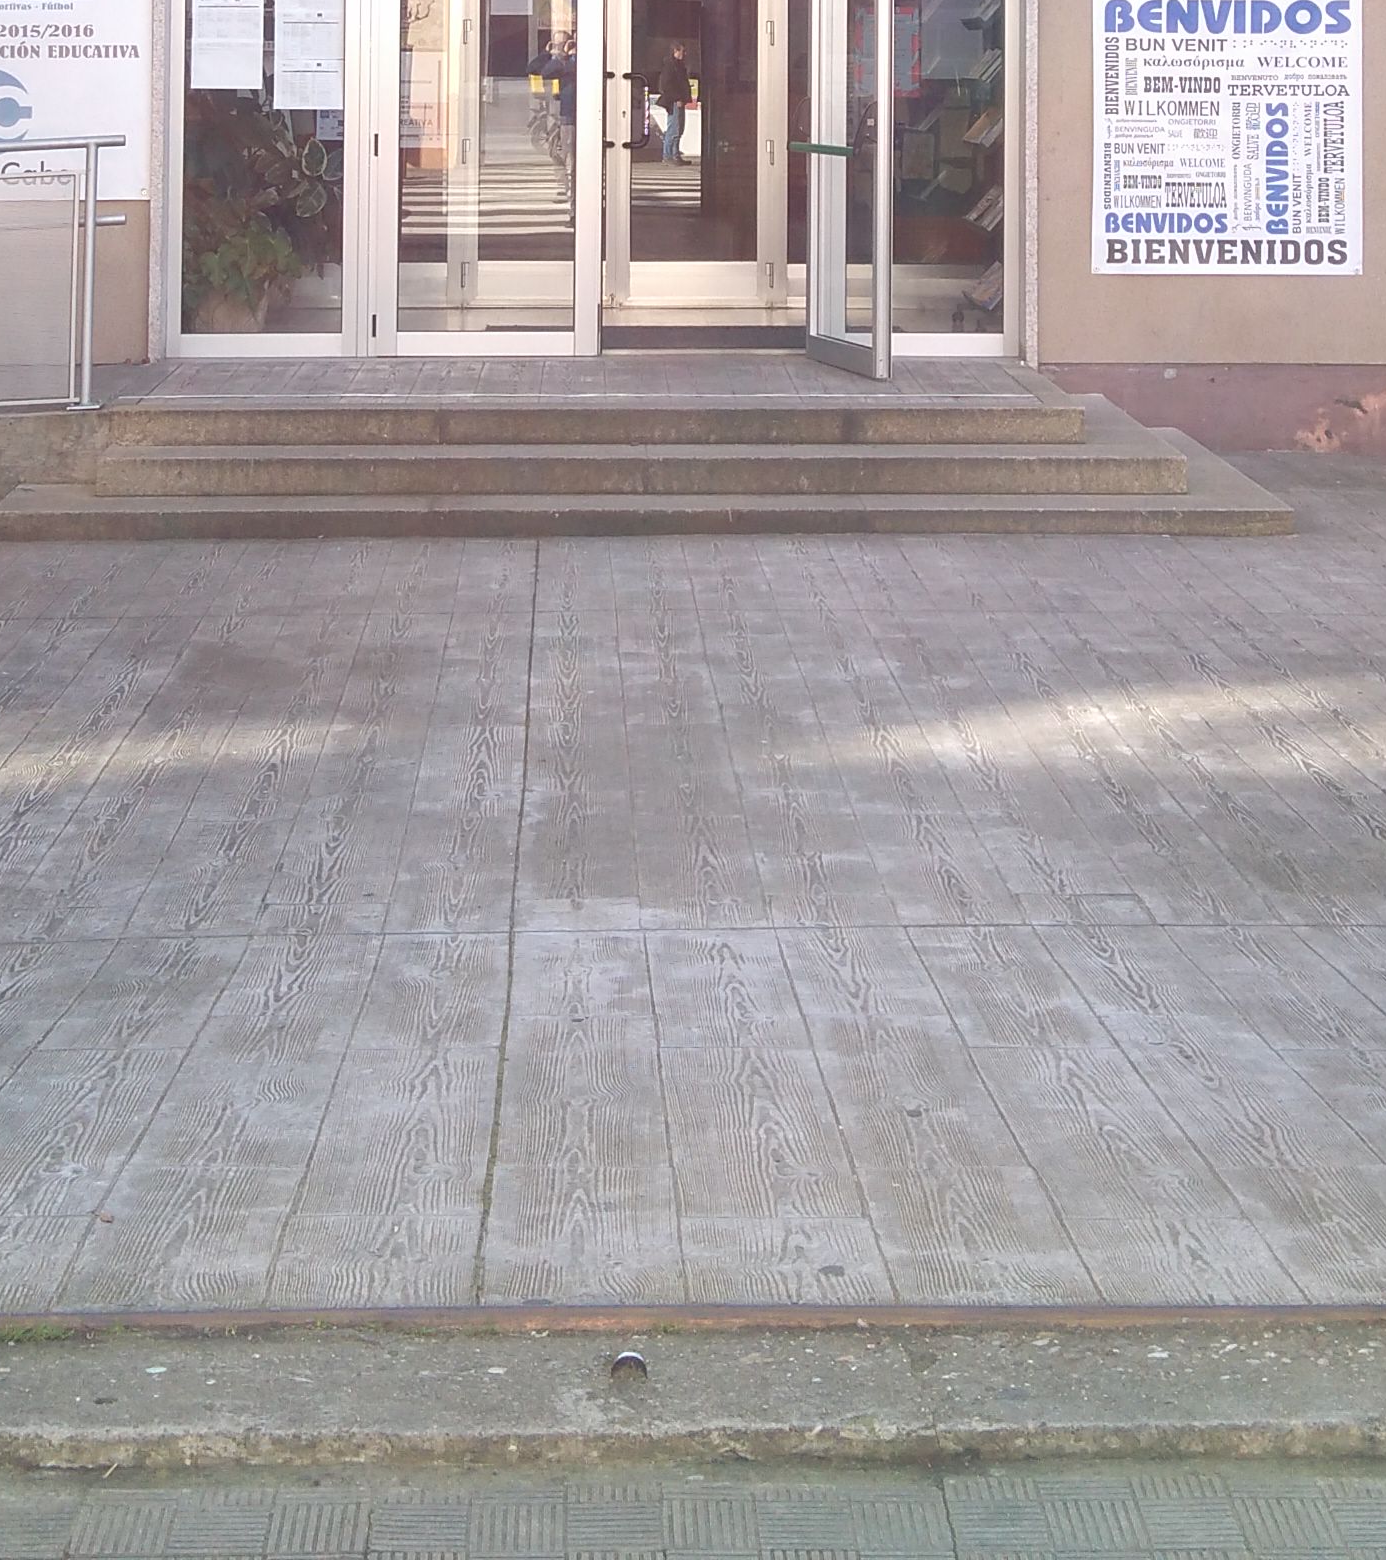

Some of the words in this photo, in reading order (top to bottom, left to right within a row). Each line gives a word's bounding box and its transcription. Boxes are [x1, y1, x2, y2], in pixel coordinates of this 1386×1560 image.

[48, 45, 141, 59] EDUCATIVA
[1125, 38, 1165, 52] BUN
[1172, 38, 1228, 52] VENIT
[1143, 55, 1245, 70] καλωσόρισμα
[1257, 56, 1348, 68] WELCOME
[1104, 36, 1120, 115] BIENVENIDOS
[1143, 76, 1221, 94] BEM-VINDO
[1228, 84, 1350, 96] TERVETULOA
[1124, 100, 1220, 116] WILKOMMEN
[1168, 118, 1216, 126] ONGIETORRI
[1232, 102, 1241, 160] ONGIETORRI
[1304, 102, 1312, 157] WELCOME
[1114, 143, 1134, 154] BUN
[1136, 143, 1166, 154] VENIT
[1246, 134, 1259, 160] SALVE
[1323, 100, 1345, 174] TERVETULOA
[1, 160, 72, 186] Cabe
[1180, 158, 1226, 168] WELCOME
[1265, 102, 1289, 234] BENVIDOS
[1103, 142, 1112, 210] BIENVENIDOS
[1123, 175, 1162, 189] BEM-VINDO
[1113, 195, 1162, 209] WILKOMMEN
[1164, 182, 1227, 209] TERVETULOA
[1243, 163, 1252, 222] BENVINGUDA
[1292, 174, 1302, 206] VENIT
[1318, 177, 1330, 223] BEM-VINDO
[1334, 177, 1346, 235] WILKOMMEN
[1105, 212, 1228, 234] BENVIDOS
[1292, 210, 1302, 234] BUN
[1106, 238, 1348, 265] BIENVENIDOS
